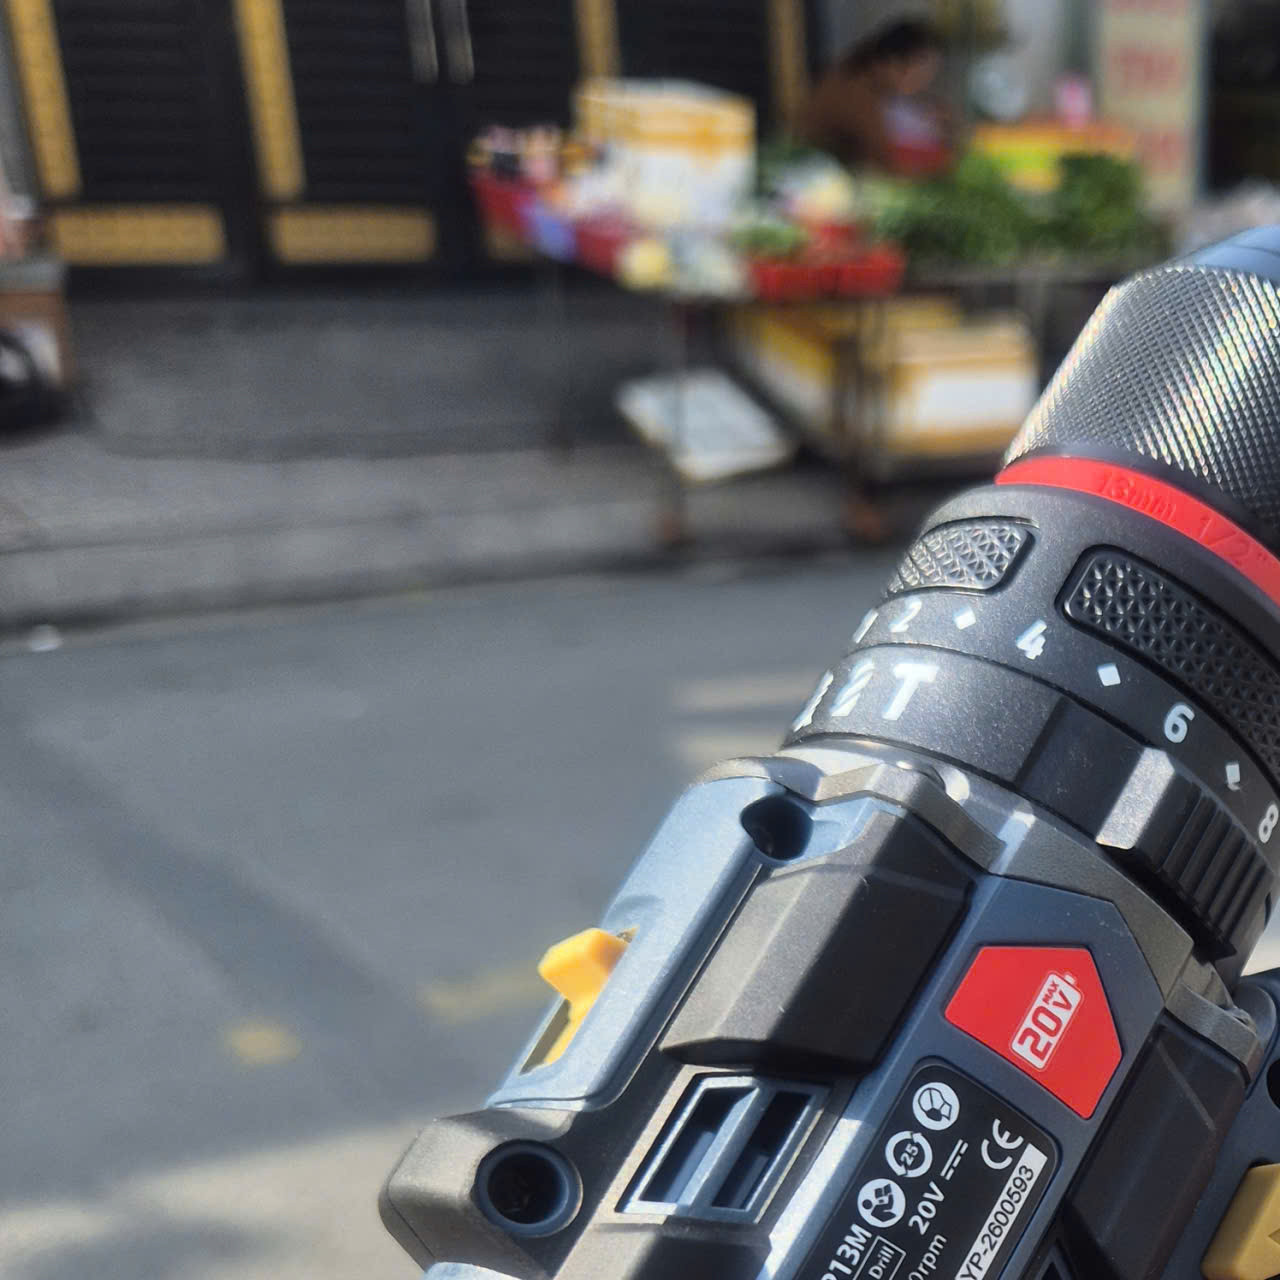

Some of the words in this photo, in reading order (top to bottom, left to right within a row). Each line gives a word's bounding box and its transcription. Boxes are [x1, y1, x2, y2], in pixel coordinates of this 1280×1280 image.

[887, 595, 923, 633] 2
[1016, 618, 1047, 660] 4
[1163, 703, 1195, 744] 6
[1257, 802, 1280, 844] 8
[1041, 979, 1061, 1006] MAX
[1017, 989, 1073, 1062] 20V
[900, 1143, 919, 1167] 25
[980, 1118, 1024, 1171] CE
[907, 1180, 945, 1236] 20V
[868, 1245, 896, 1280] Drill
